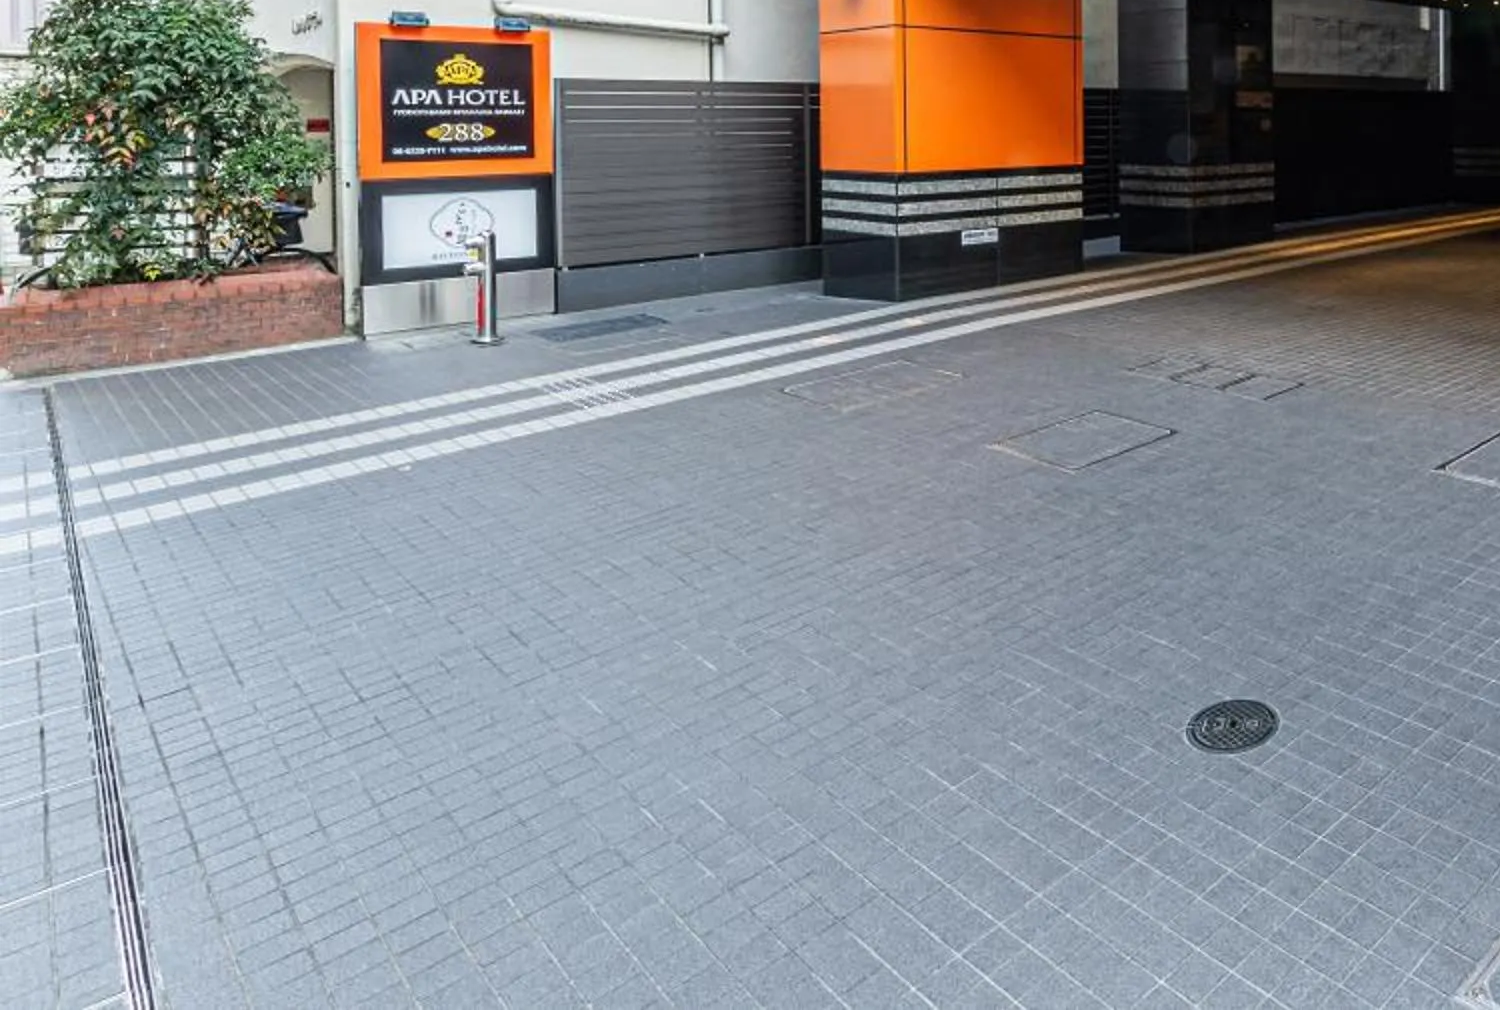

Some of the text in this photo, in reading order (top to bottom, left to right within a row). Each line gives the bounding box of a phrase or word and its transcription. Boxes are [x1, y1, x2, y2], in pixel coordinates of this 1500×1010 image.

[391, 89, 526, 105] APA HOTEL
[438, 122, 485, 141] 288
